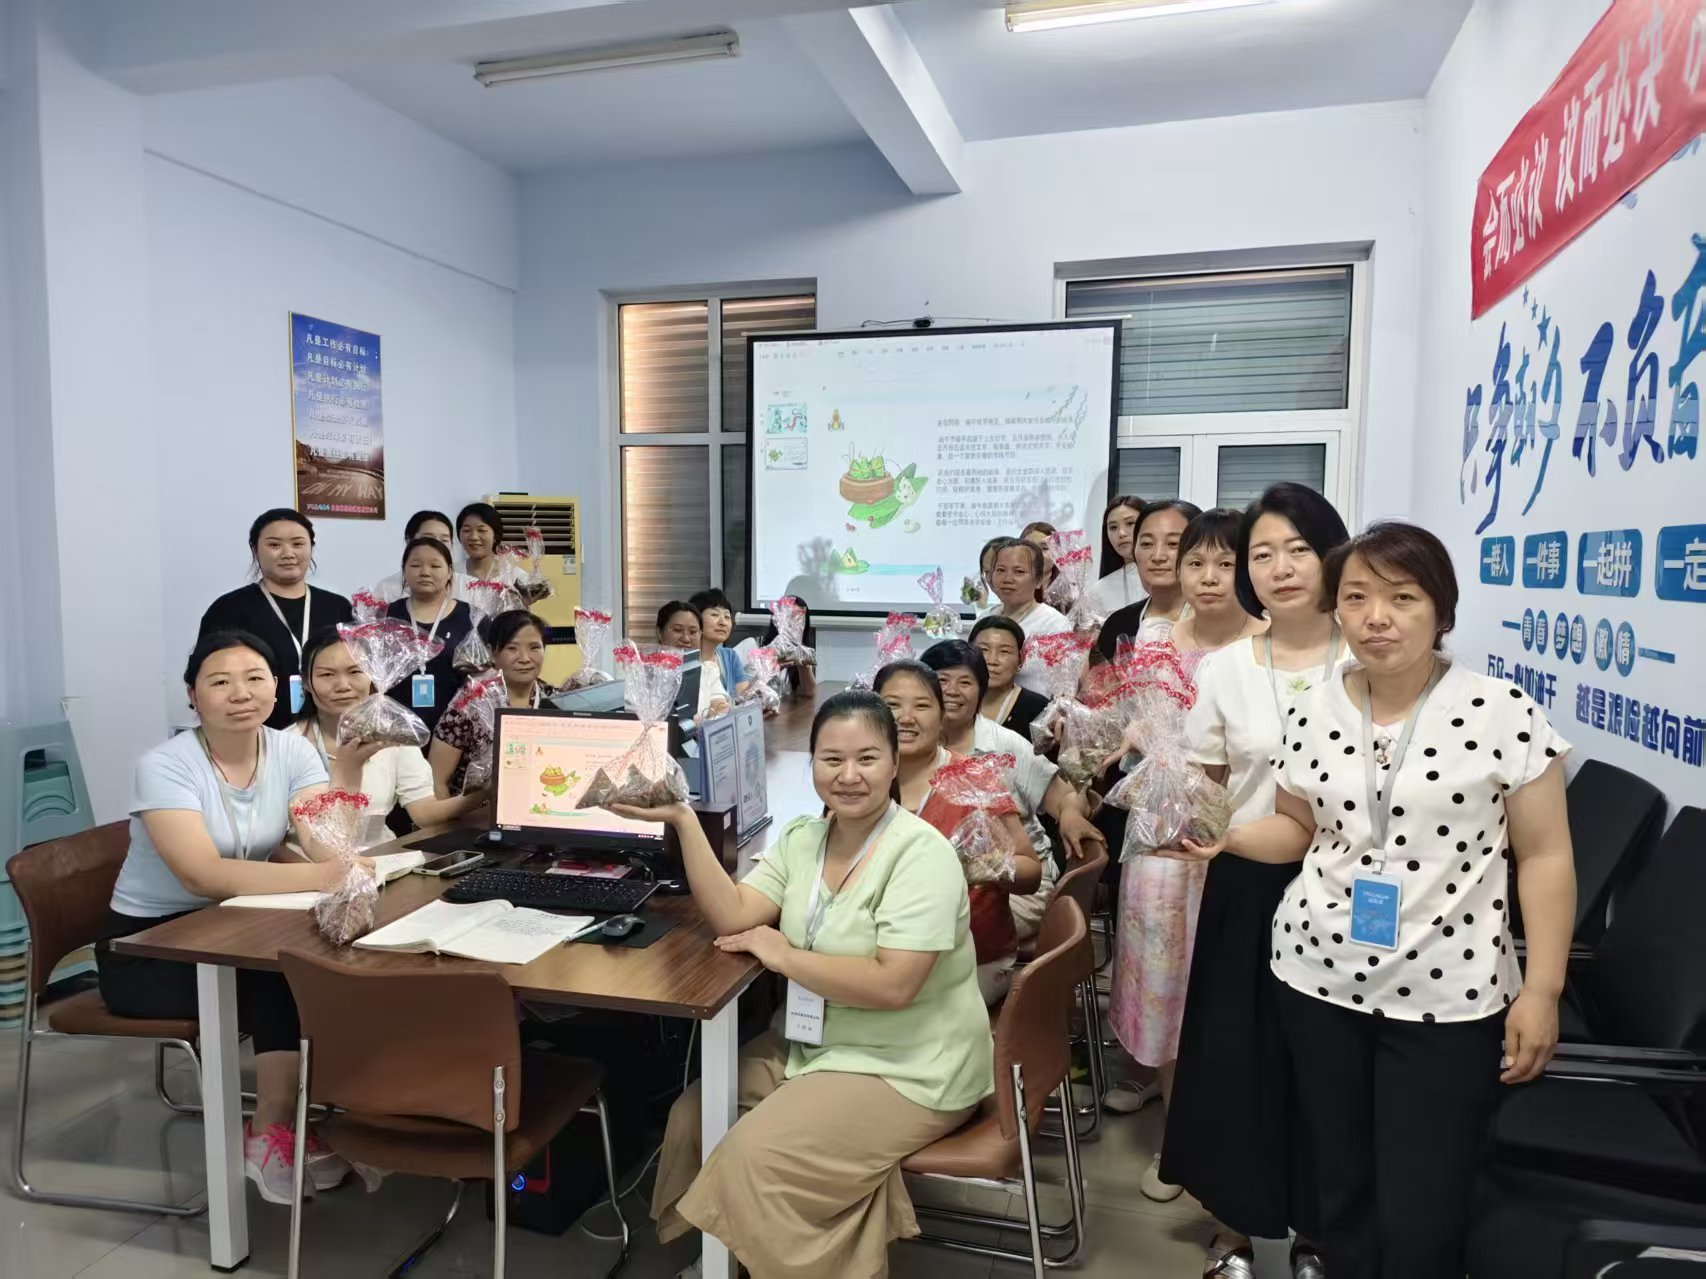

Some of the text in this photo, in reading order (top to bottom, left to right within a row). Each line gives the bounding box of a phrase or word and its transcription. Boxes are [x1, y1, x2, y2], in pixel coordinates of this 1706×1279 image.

[306, 333, 366, 356] 凡是工作必有目标
[1483, 543, 1509, 578] 一群人
[1526, 540, 1561, 583] 一件事
[1582, 540, 1633, 588] 一起拼
[1575, 682, 1706, 768] 越是艰险越向前
